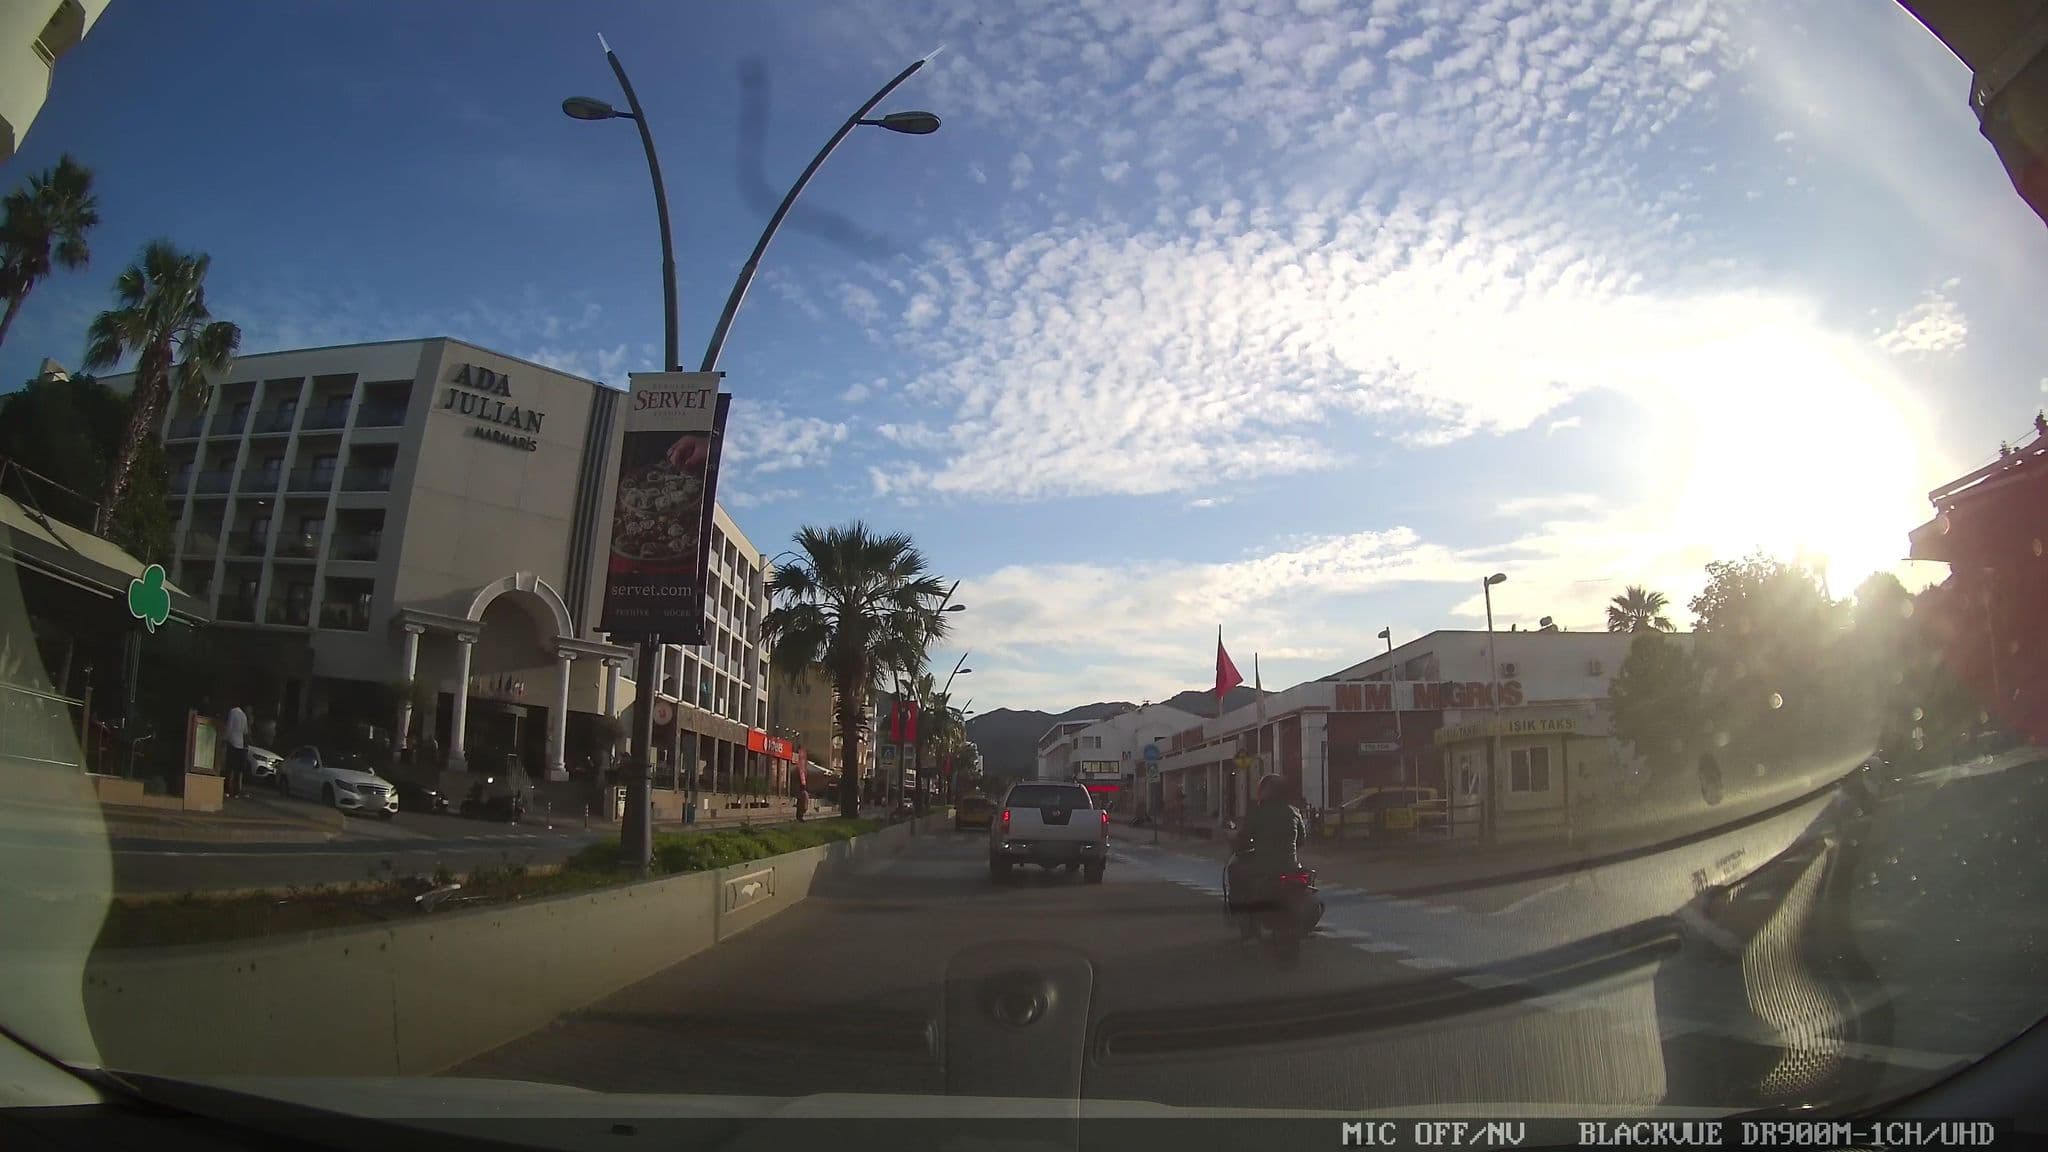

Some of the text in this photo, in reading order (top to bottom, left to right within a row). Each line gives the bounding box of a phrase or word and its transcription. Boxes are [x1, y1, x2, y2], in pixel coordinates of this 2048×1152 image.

[453, 363, 511, 397] ADA
[445, 388, 545, 433] JULIAN
[634, 389, 712, 411] SERVET
[611, 584, 692, 597] servet.com
